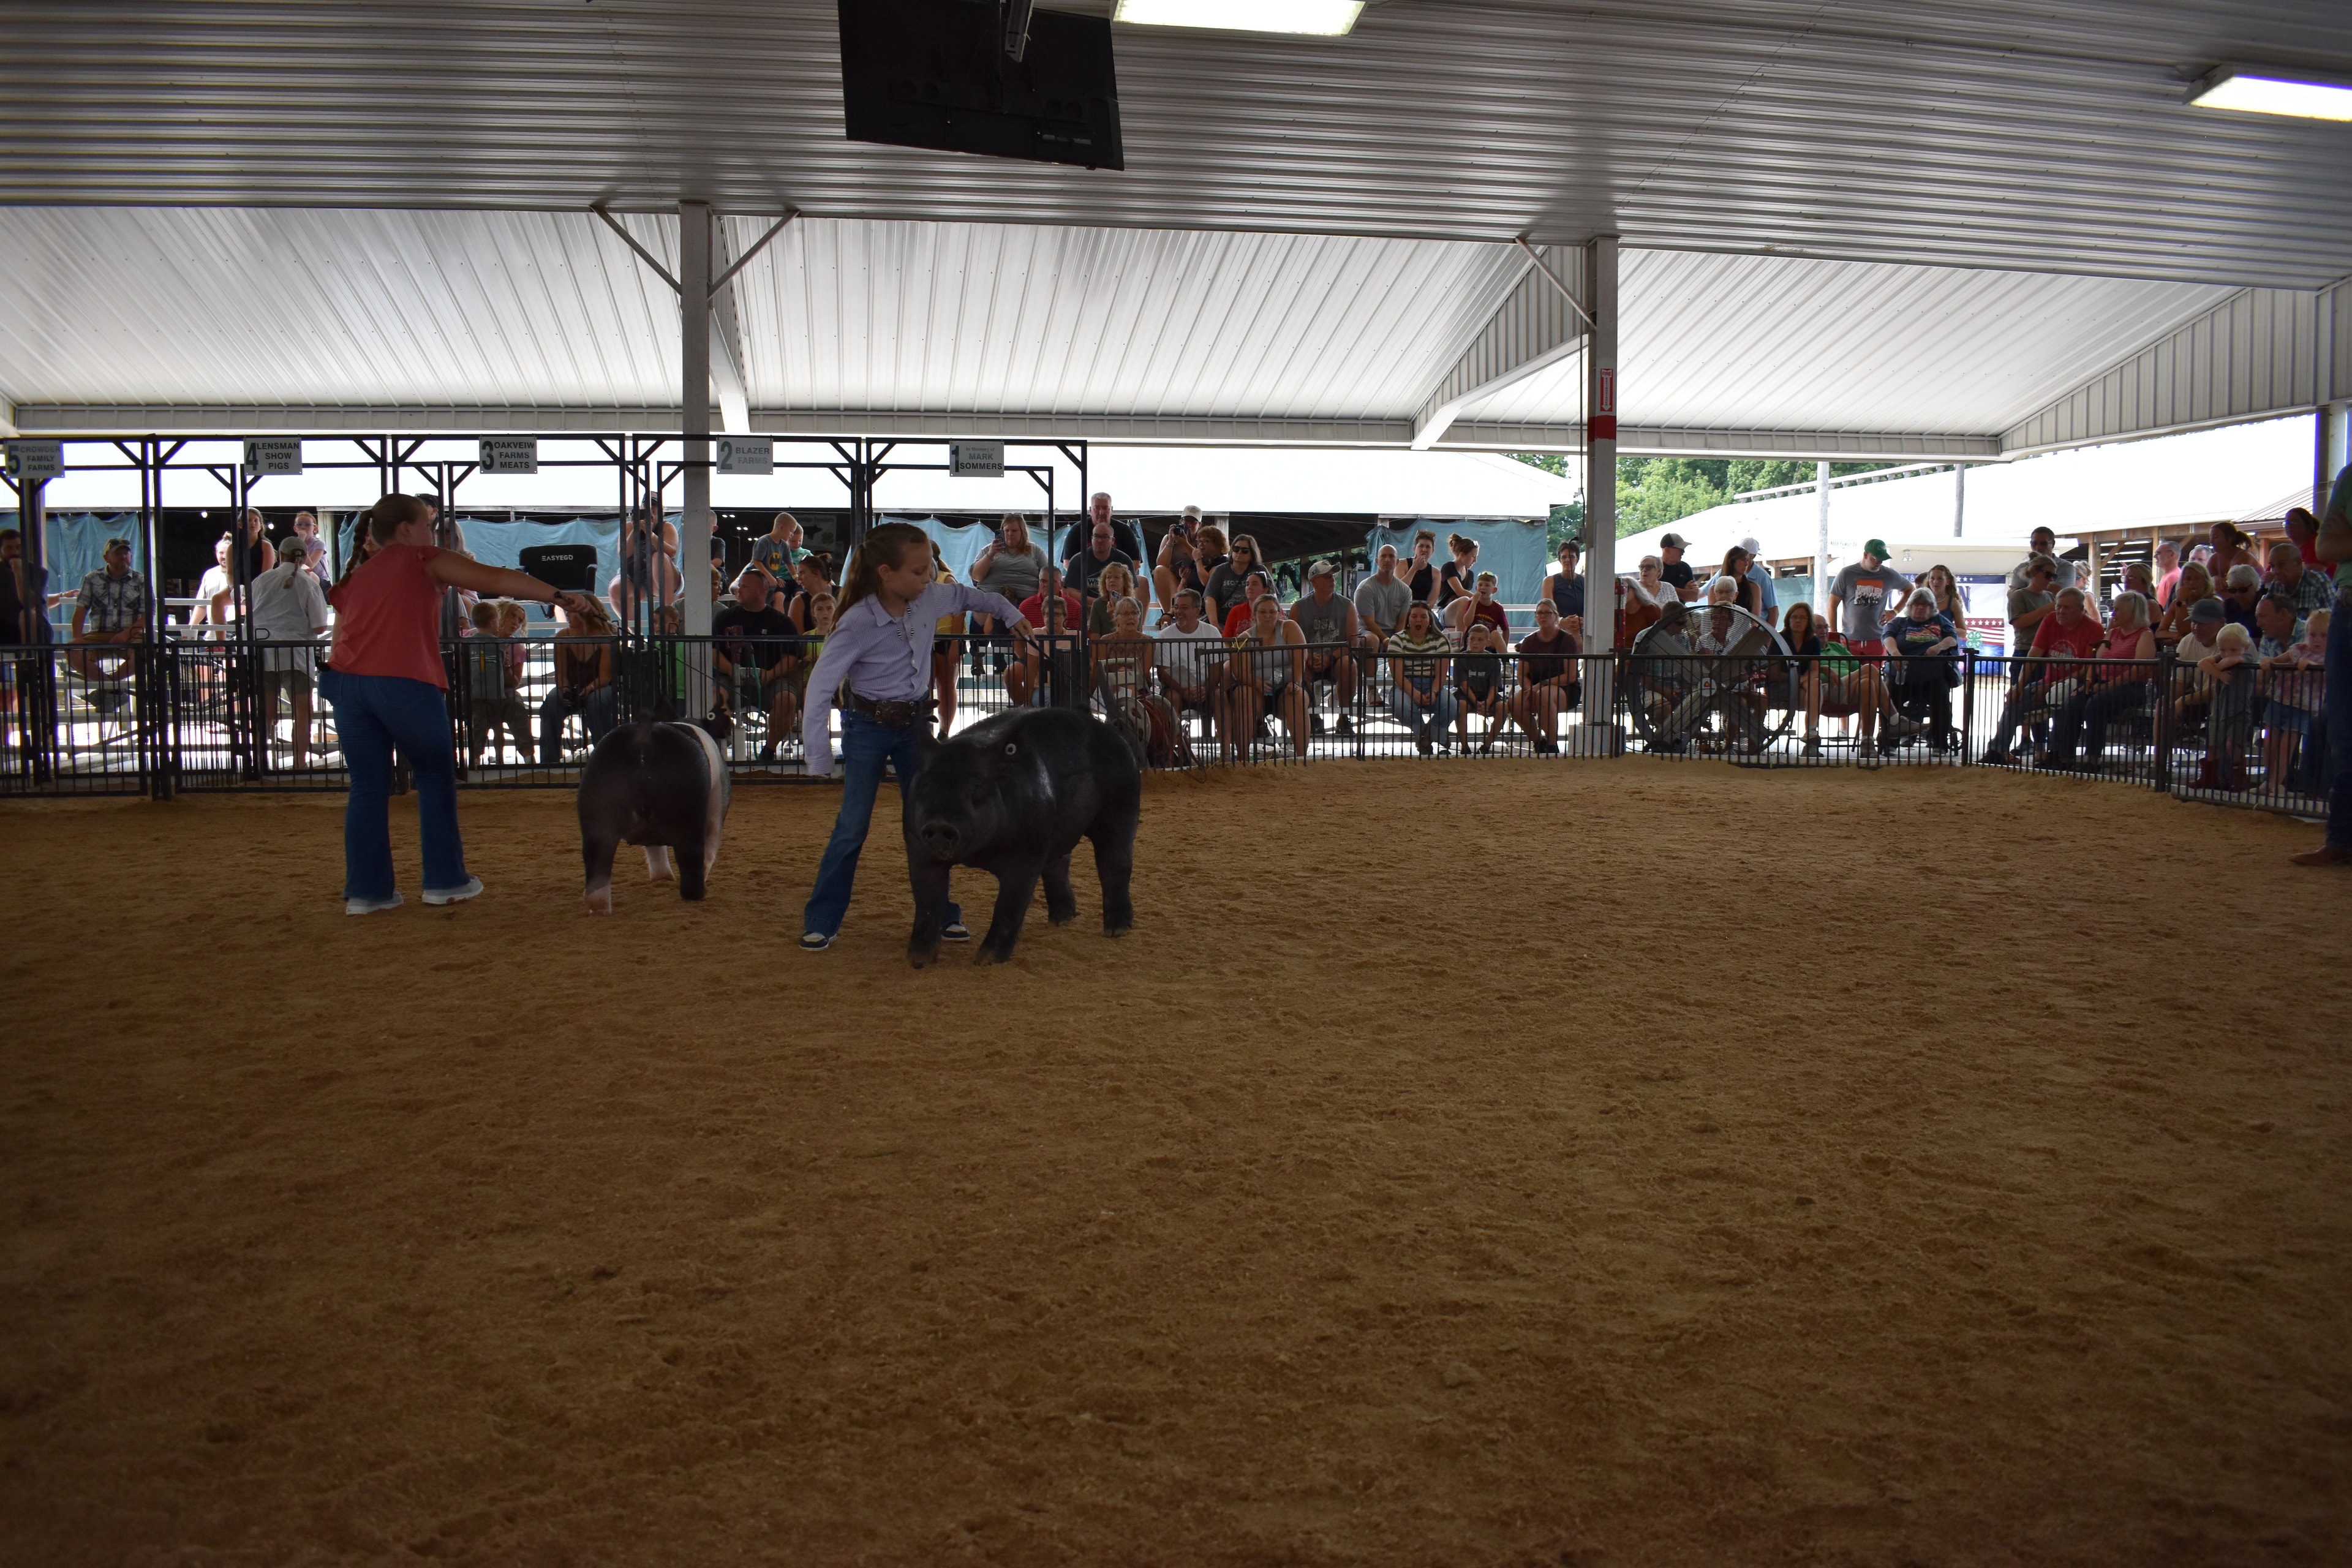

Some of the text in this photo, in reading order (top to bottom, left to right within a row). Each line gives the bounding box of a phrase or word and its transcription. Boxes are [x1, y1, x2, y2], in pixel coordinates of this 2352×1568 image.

[8, 445, 21, 474] 5
[246, 442, 258, 470] 4
[482, 440, 494, 470] 3
[720, 441, 733, 470] 2
[951, 445, 959, 472] 1
